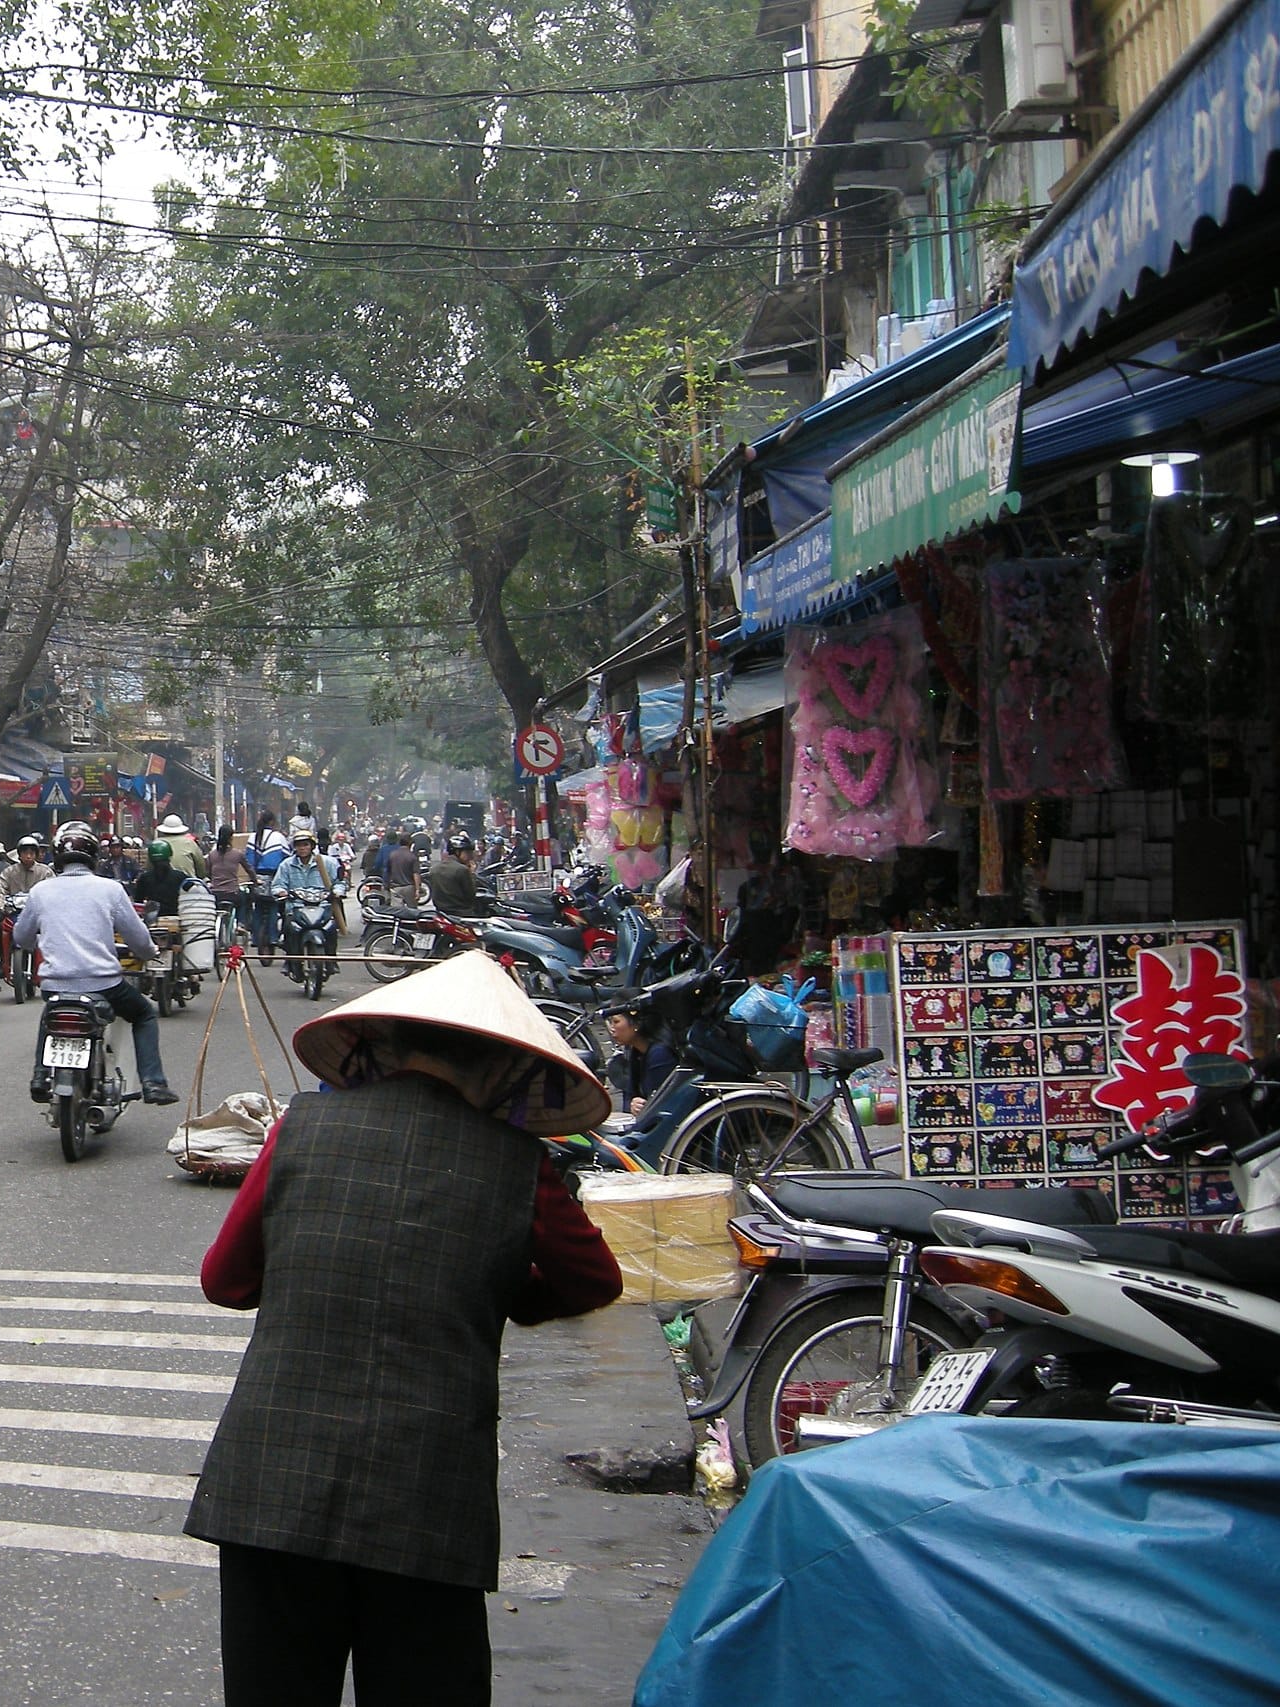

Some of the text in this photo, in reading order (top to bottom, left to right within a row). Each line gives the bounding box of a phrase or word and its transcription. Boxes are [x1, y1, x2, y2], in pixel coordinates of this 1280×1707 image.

[50, 1051, 83, 1066] 2192
[929, 1354, 983, 1382] 29-X4
[911, 1382, 964, 1411] 7232
